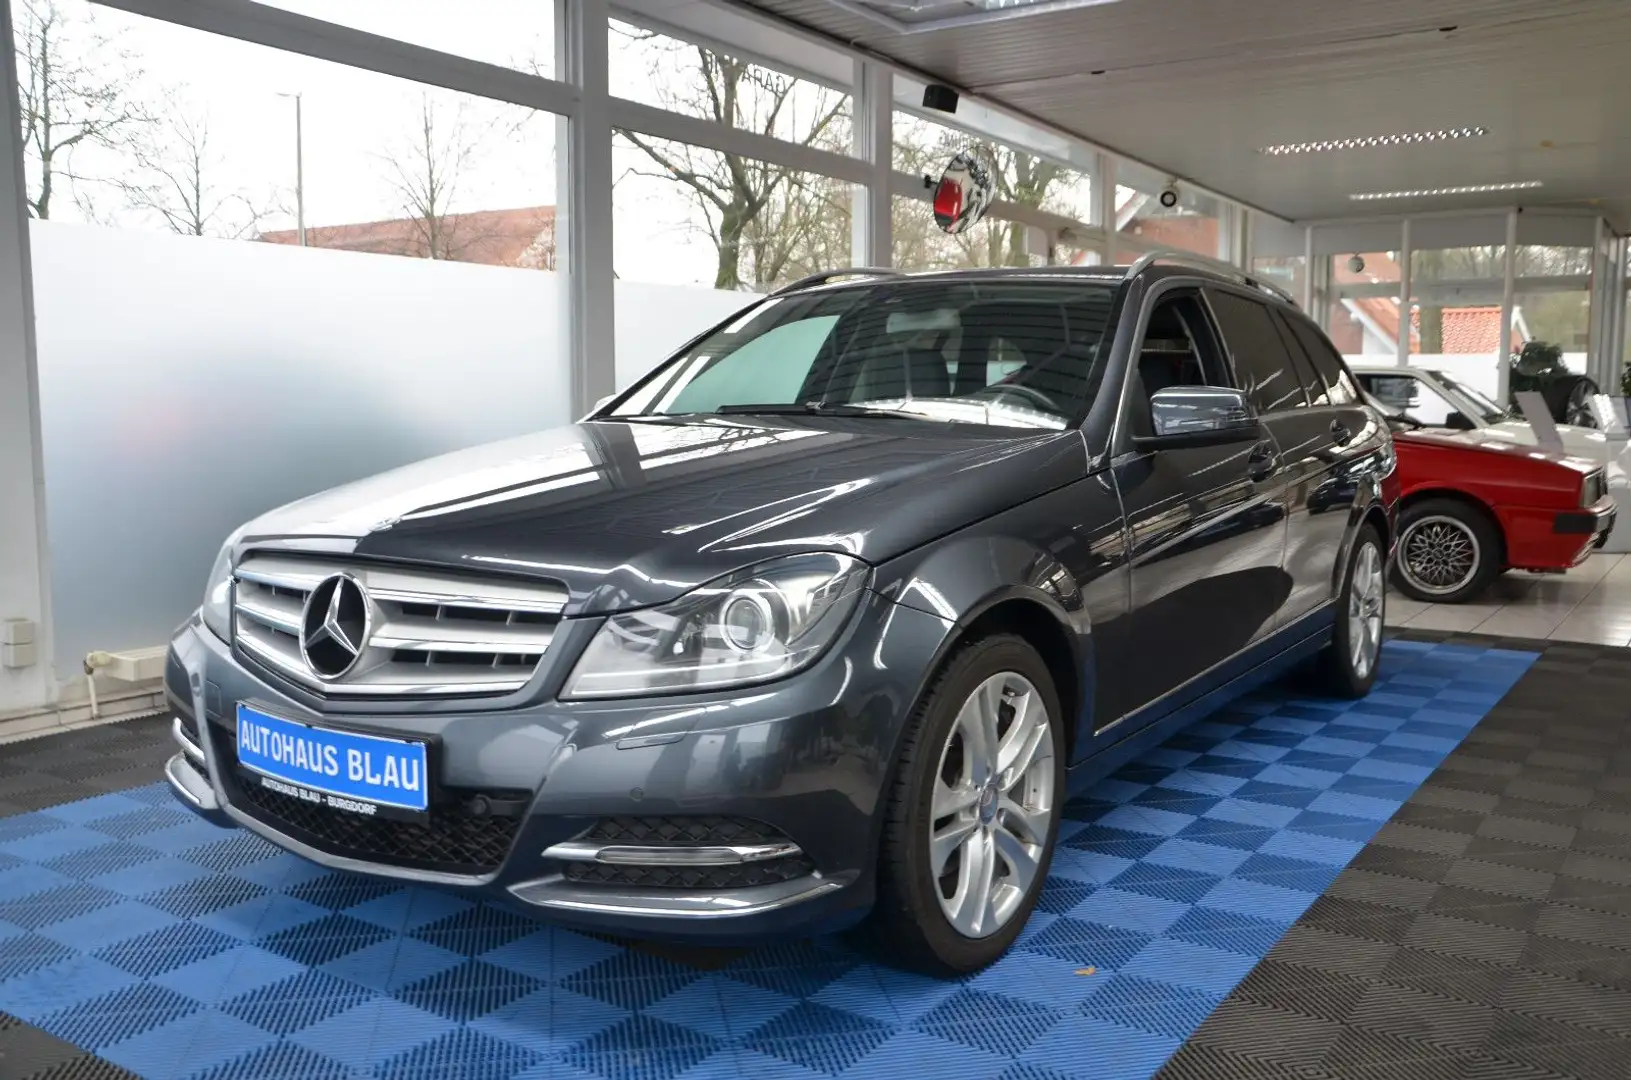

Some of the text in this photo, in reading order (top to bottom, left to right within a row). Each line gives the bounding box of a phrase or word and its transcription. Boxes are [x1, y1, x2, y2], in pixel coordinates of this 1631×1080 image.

[241, 720, 420, 791] AUTOHAUS BLAU
[261, 777, 299, 797] AUTOHAUS
[299, 788, 320, 803] BLAU
[327, 795, 377, 815] BURGDORF
